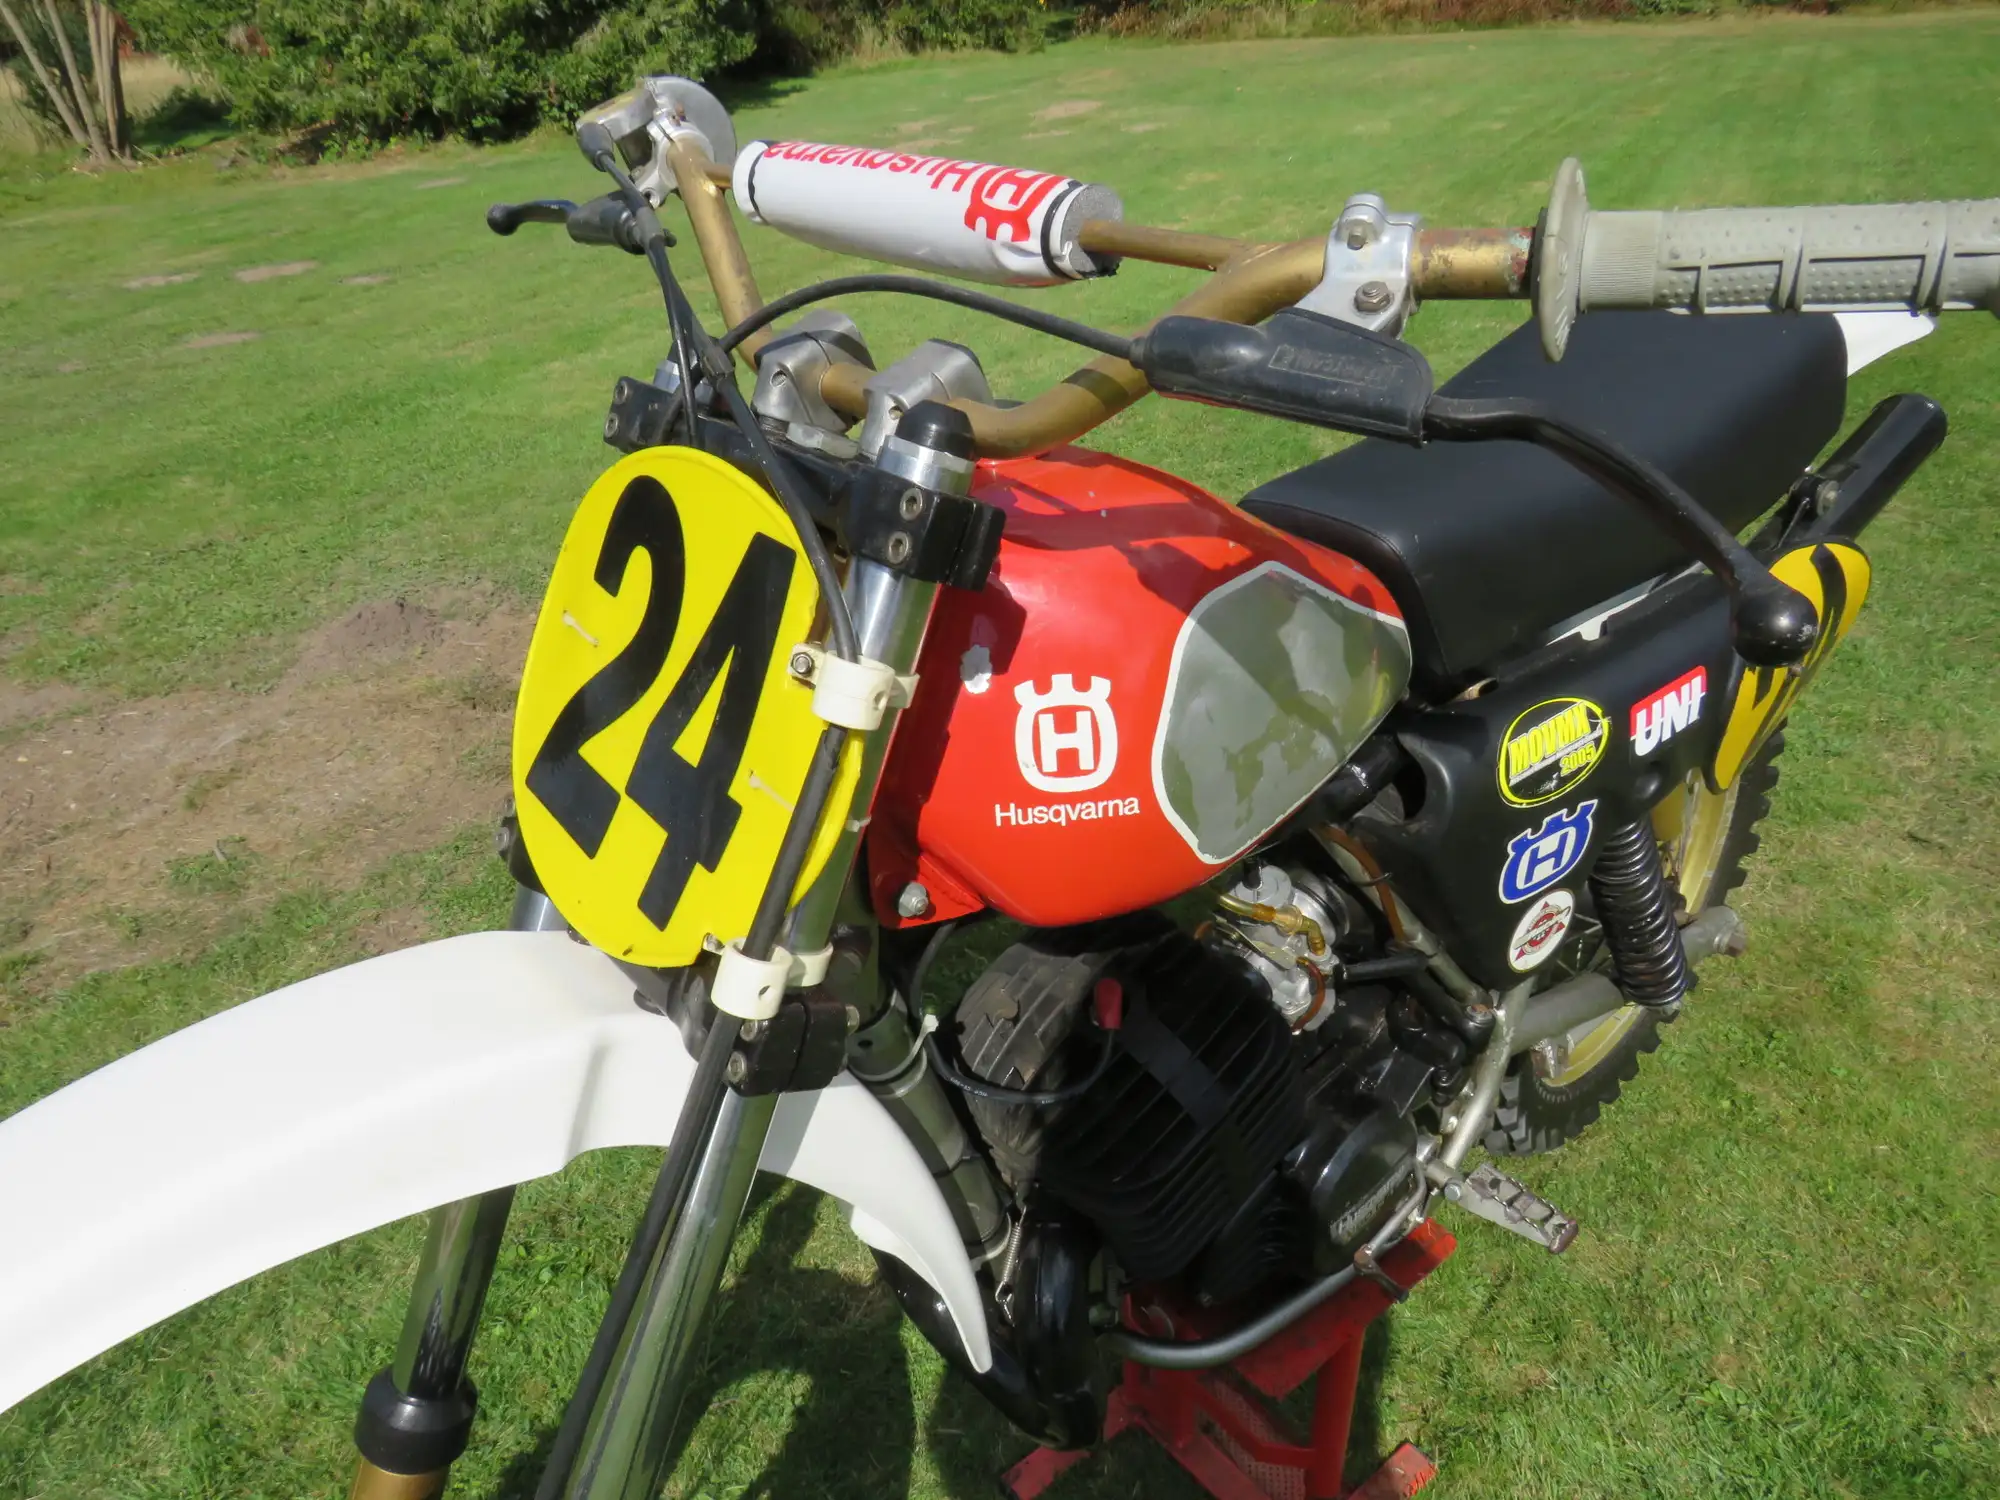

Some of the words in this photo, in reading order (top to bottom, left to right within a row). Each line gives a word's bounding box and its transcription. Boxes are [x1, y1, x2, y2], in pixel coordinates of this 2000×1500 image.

[525, 475, 796, 931] 24
[1635, 675, 1702, 756] UNI
[1561, 743, 1595, 777] 2005
[994, 797, 1140, 827] Husqvarna
